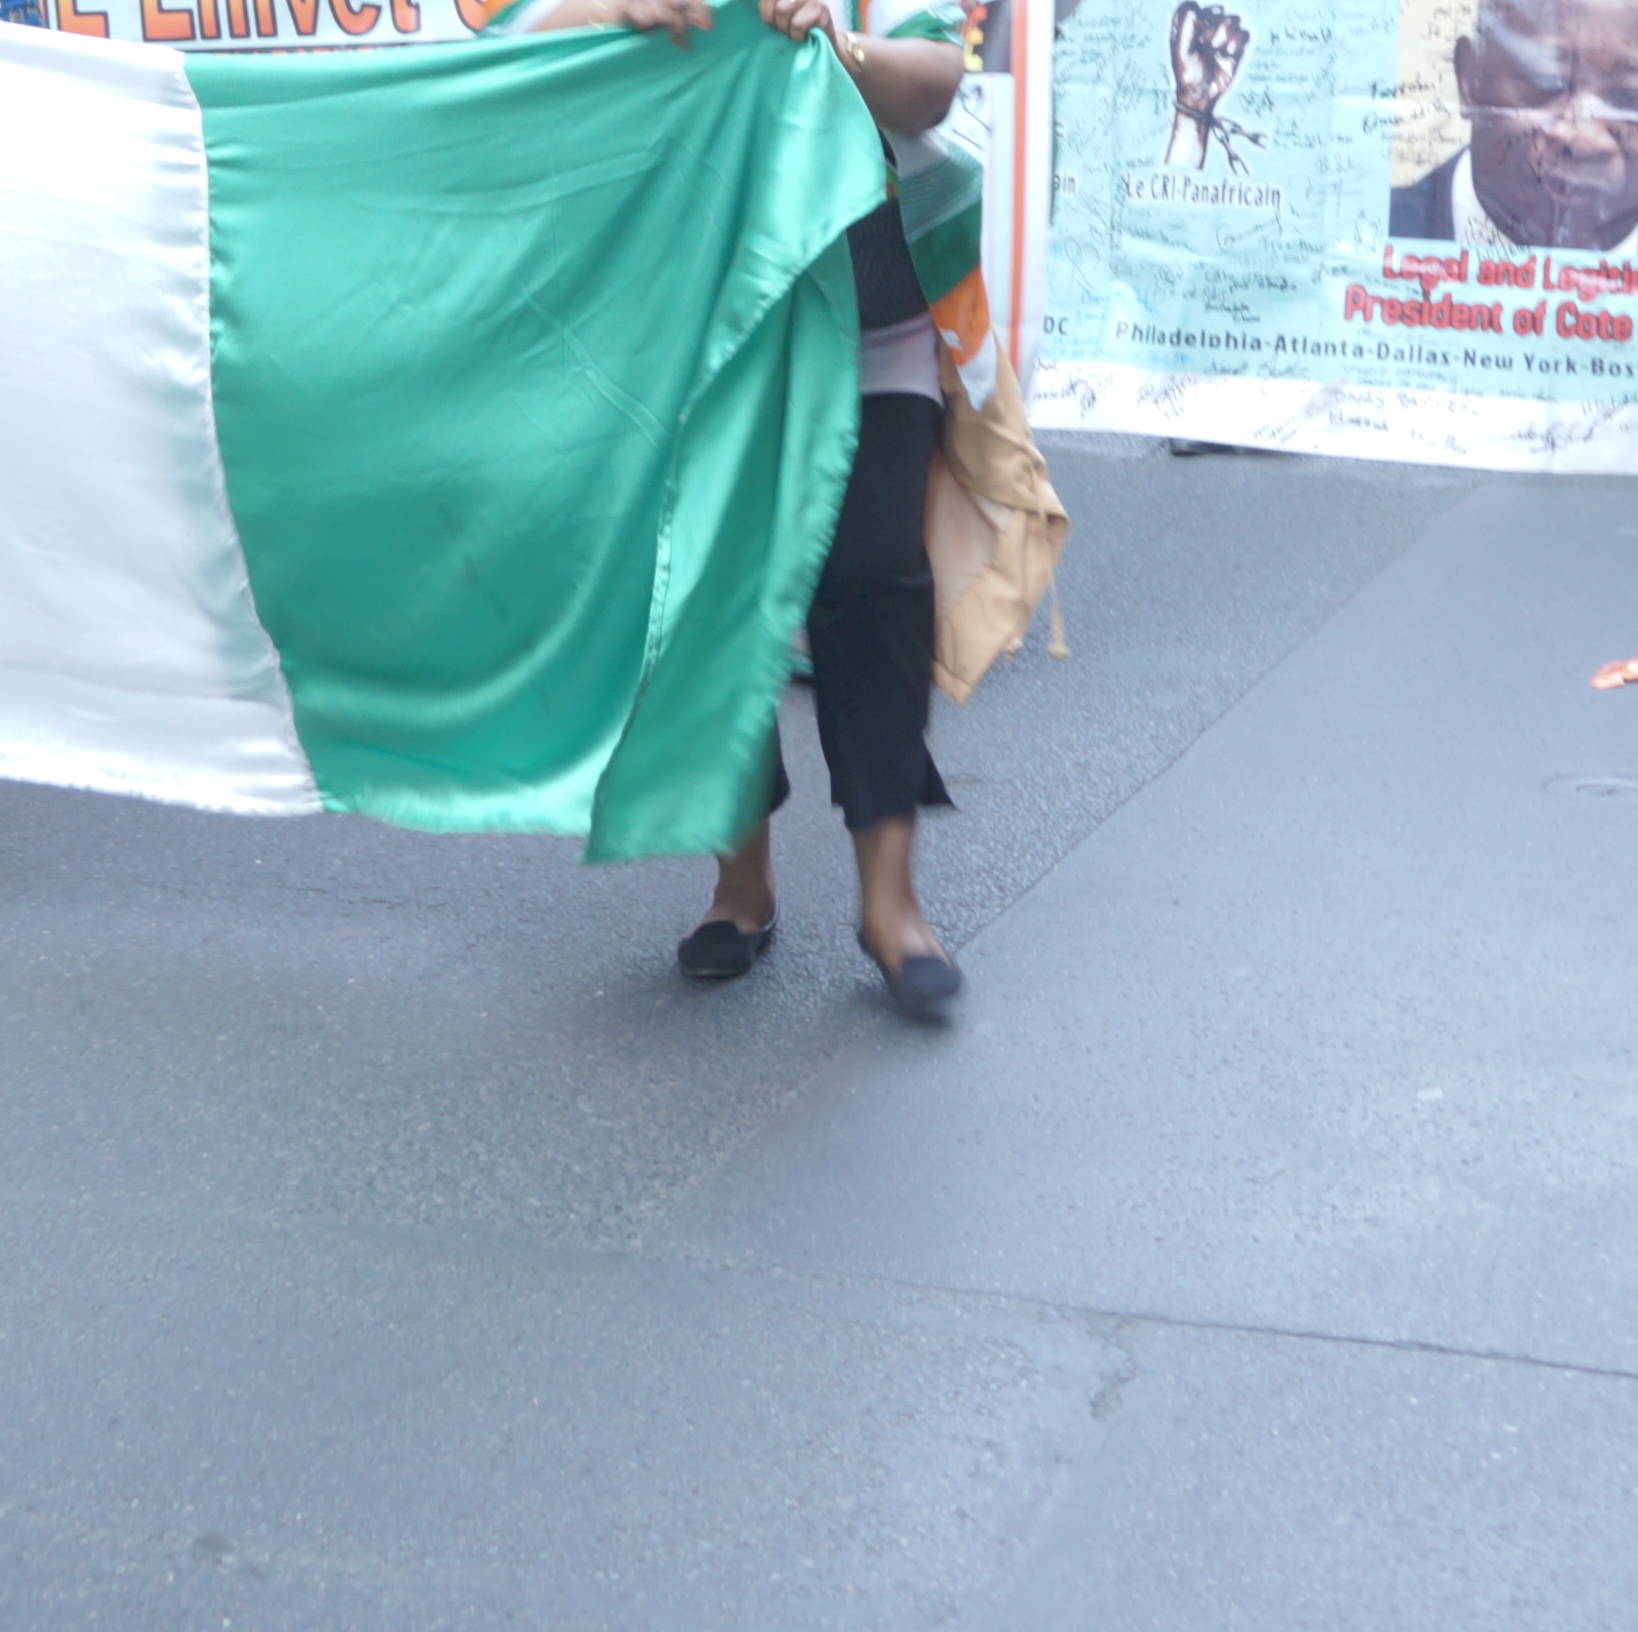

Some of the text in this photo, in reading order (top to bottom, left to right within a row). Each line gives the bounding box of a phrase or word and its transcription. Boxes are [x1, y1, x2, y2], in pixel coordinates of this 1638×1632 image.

[1382, 244, 1469, 290] Legal
[1477, 254, 1537, 289] and
[1042, 315, 1069, 336] DC
[1343, 284, 1504, 331] President
[1513, 300, 1547, 336] of
[1556, 302, 1633, 342] Cote
